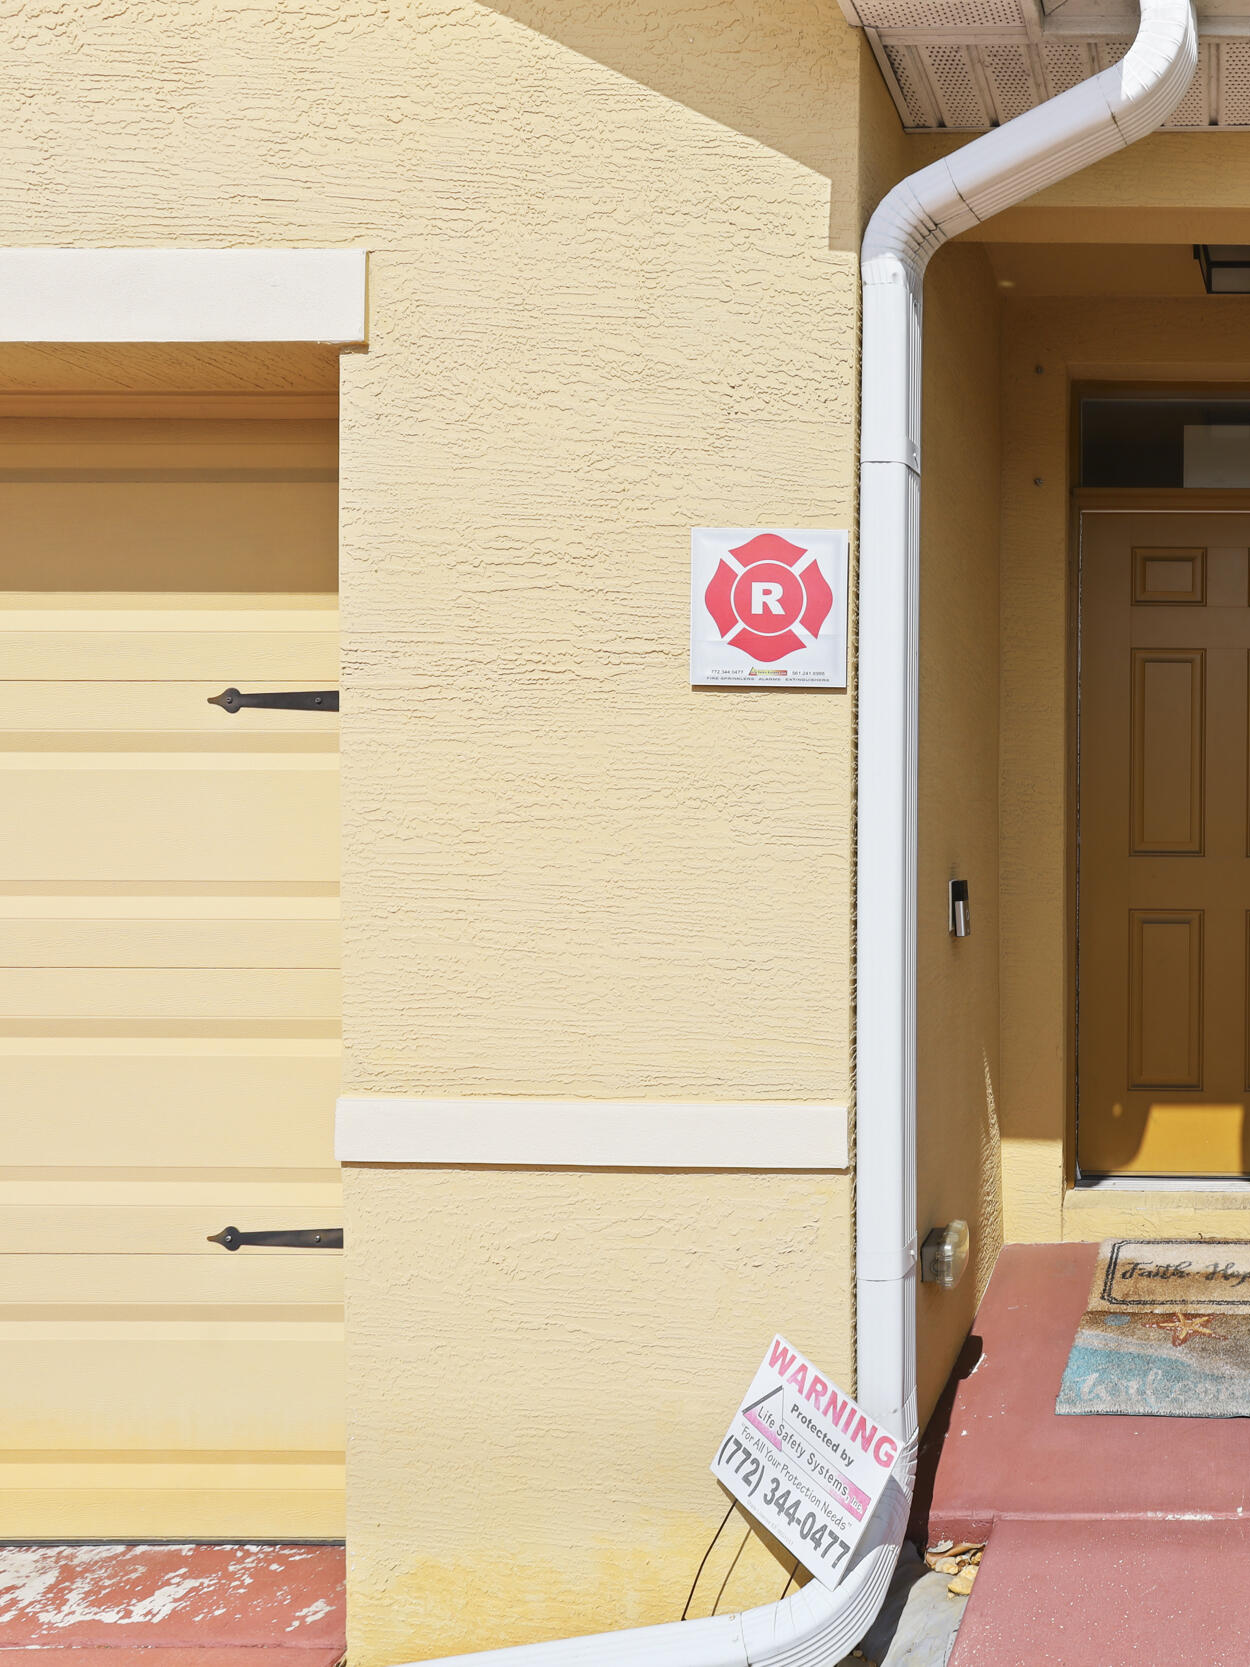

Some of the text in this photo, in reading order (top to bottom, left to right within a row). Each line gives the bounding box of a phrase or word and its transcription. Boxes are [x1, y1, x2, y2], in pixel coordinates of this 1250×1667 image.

[751, 582, 786, 615] R
[1121, 1260, 1192, 1280] Faith
[769, 1339, 897, 1469] WARNING
[791, 1404, 854, 1467] Protected by
[753, 1438, 765, 1452] All
[764, 1448, 781, 1469] Your
[781, 1464, 821, 1508] Protection
[758, 1406, 776, 1429] Life
[776, 1425, 806, 1459] Safety
[807, 1453, 850, 1500] Systems,
[717, 1434, 765, 1497] (772)
[763, 1478, 851, 1569] 344-0477
